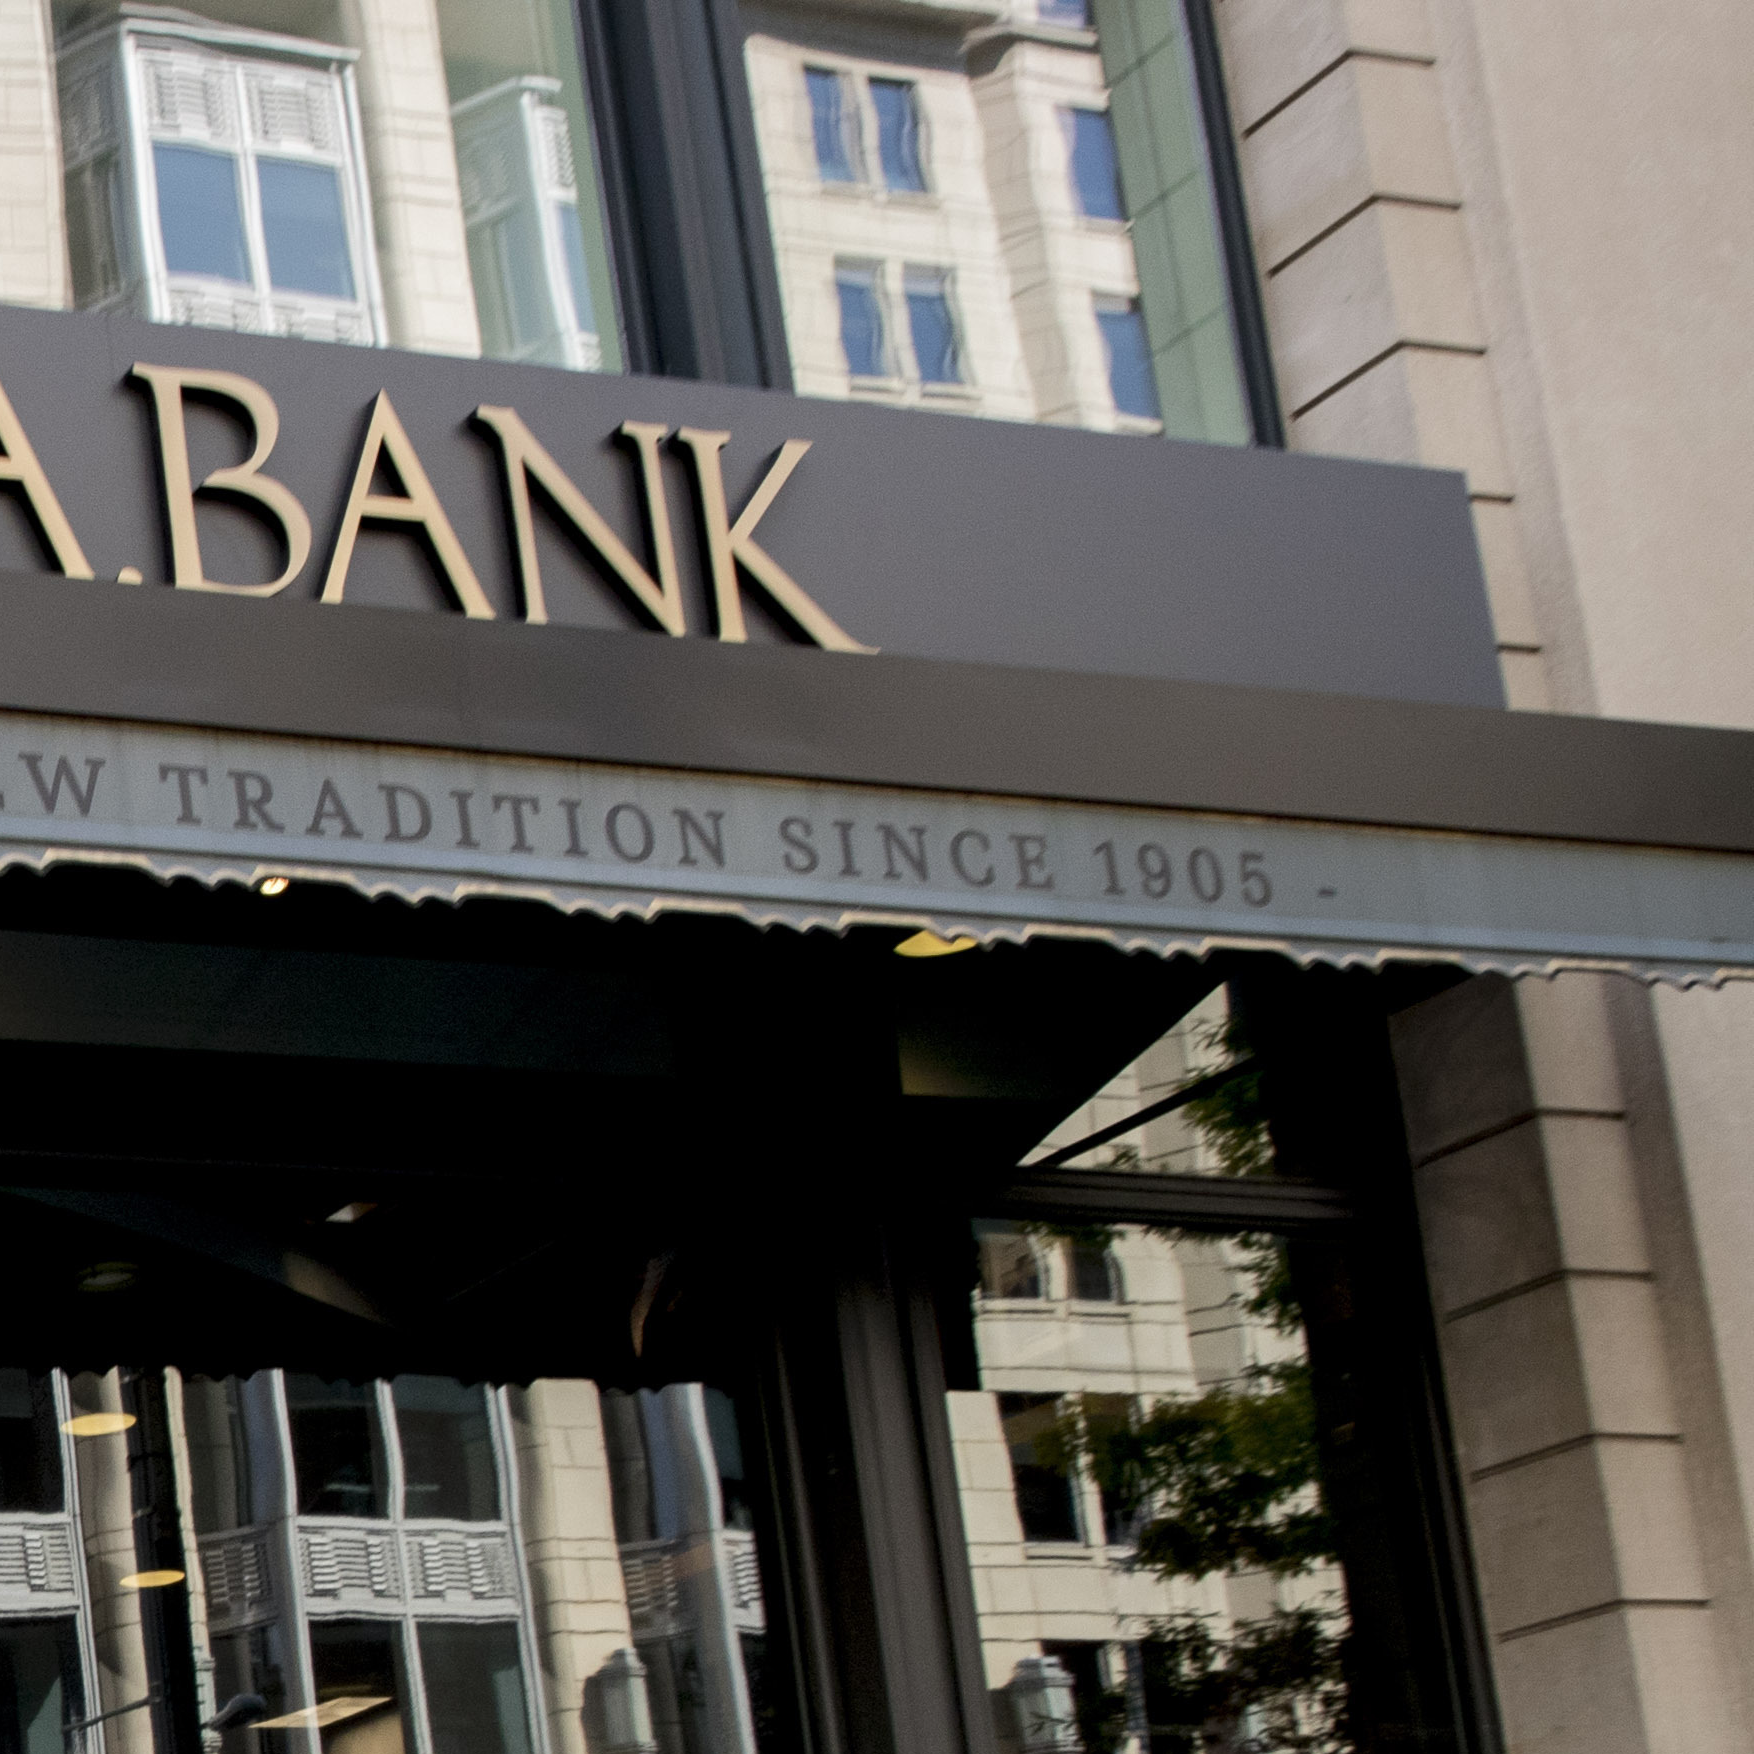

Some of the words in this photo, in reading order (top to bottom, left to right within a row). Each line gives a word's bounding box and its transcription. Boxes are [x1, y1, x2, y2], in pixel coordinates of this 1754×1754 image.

[131, 362, 882, 655] BANK
[158, 763, 727, 869] TRADITION
[779, 818, 1057, 892] SINCE
[1092, 840, 1275, 908] 1905
